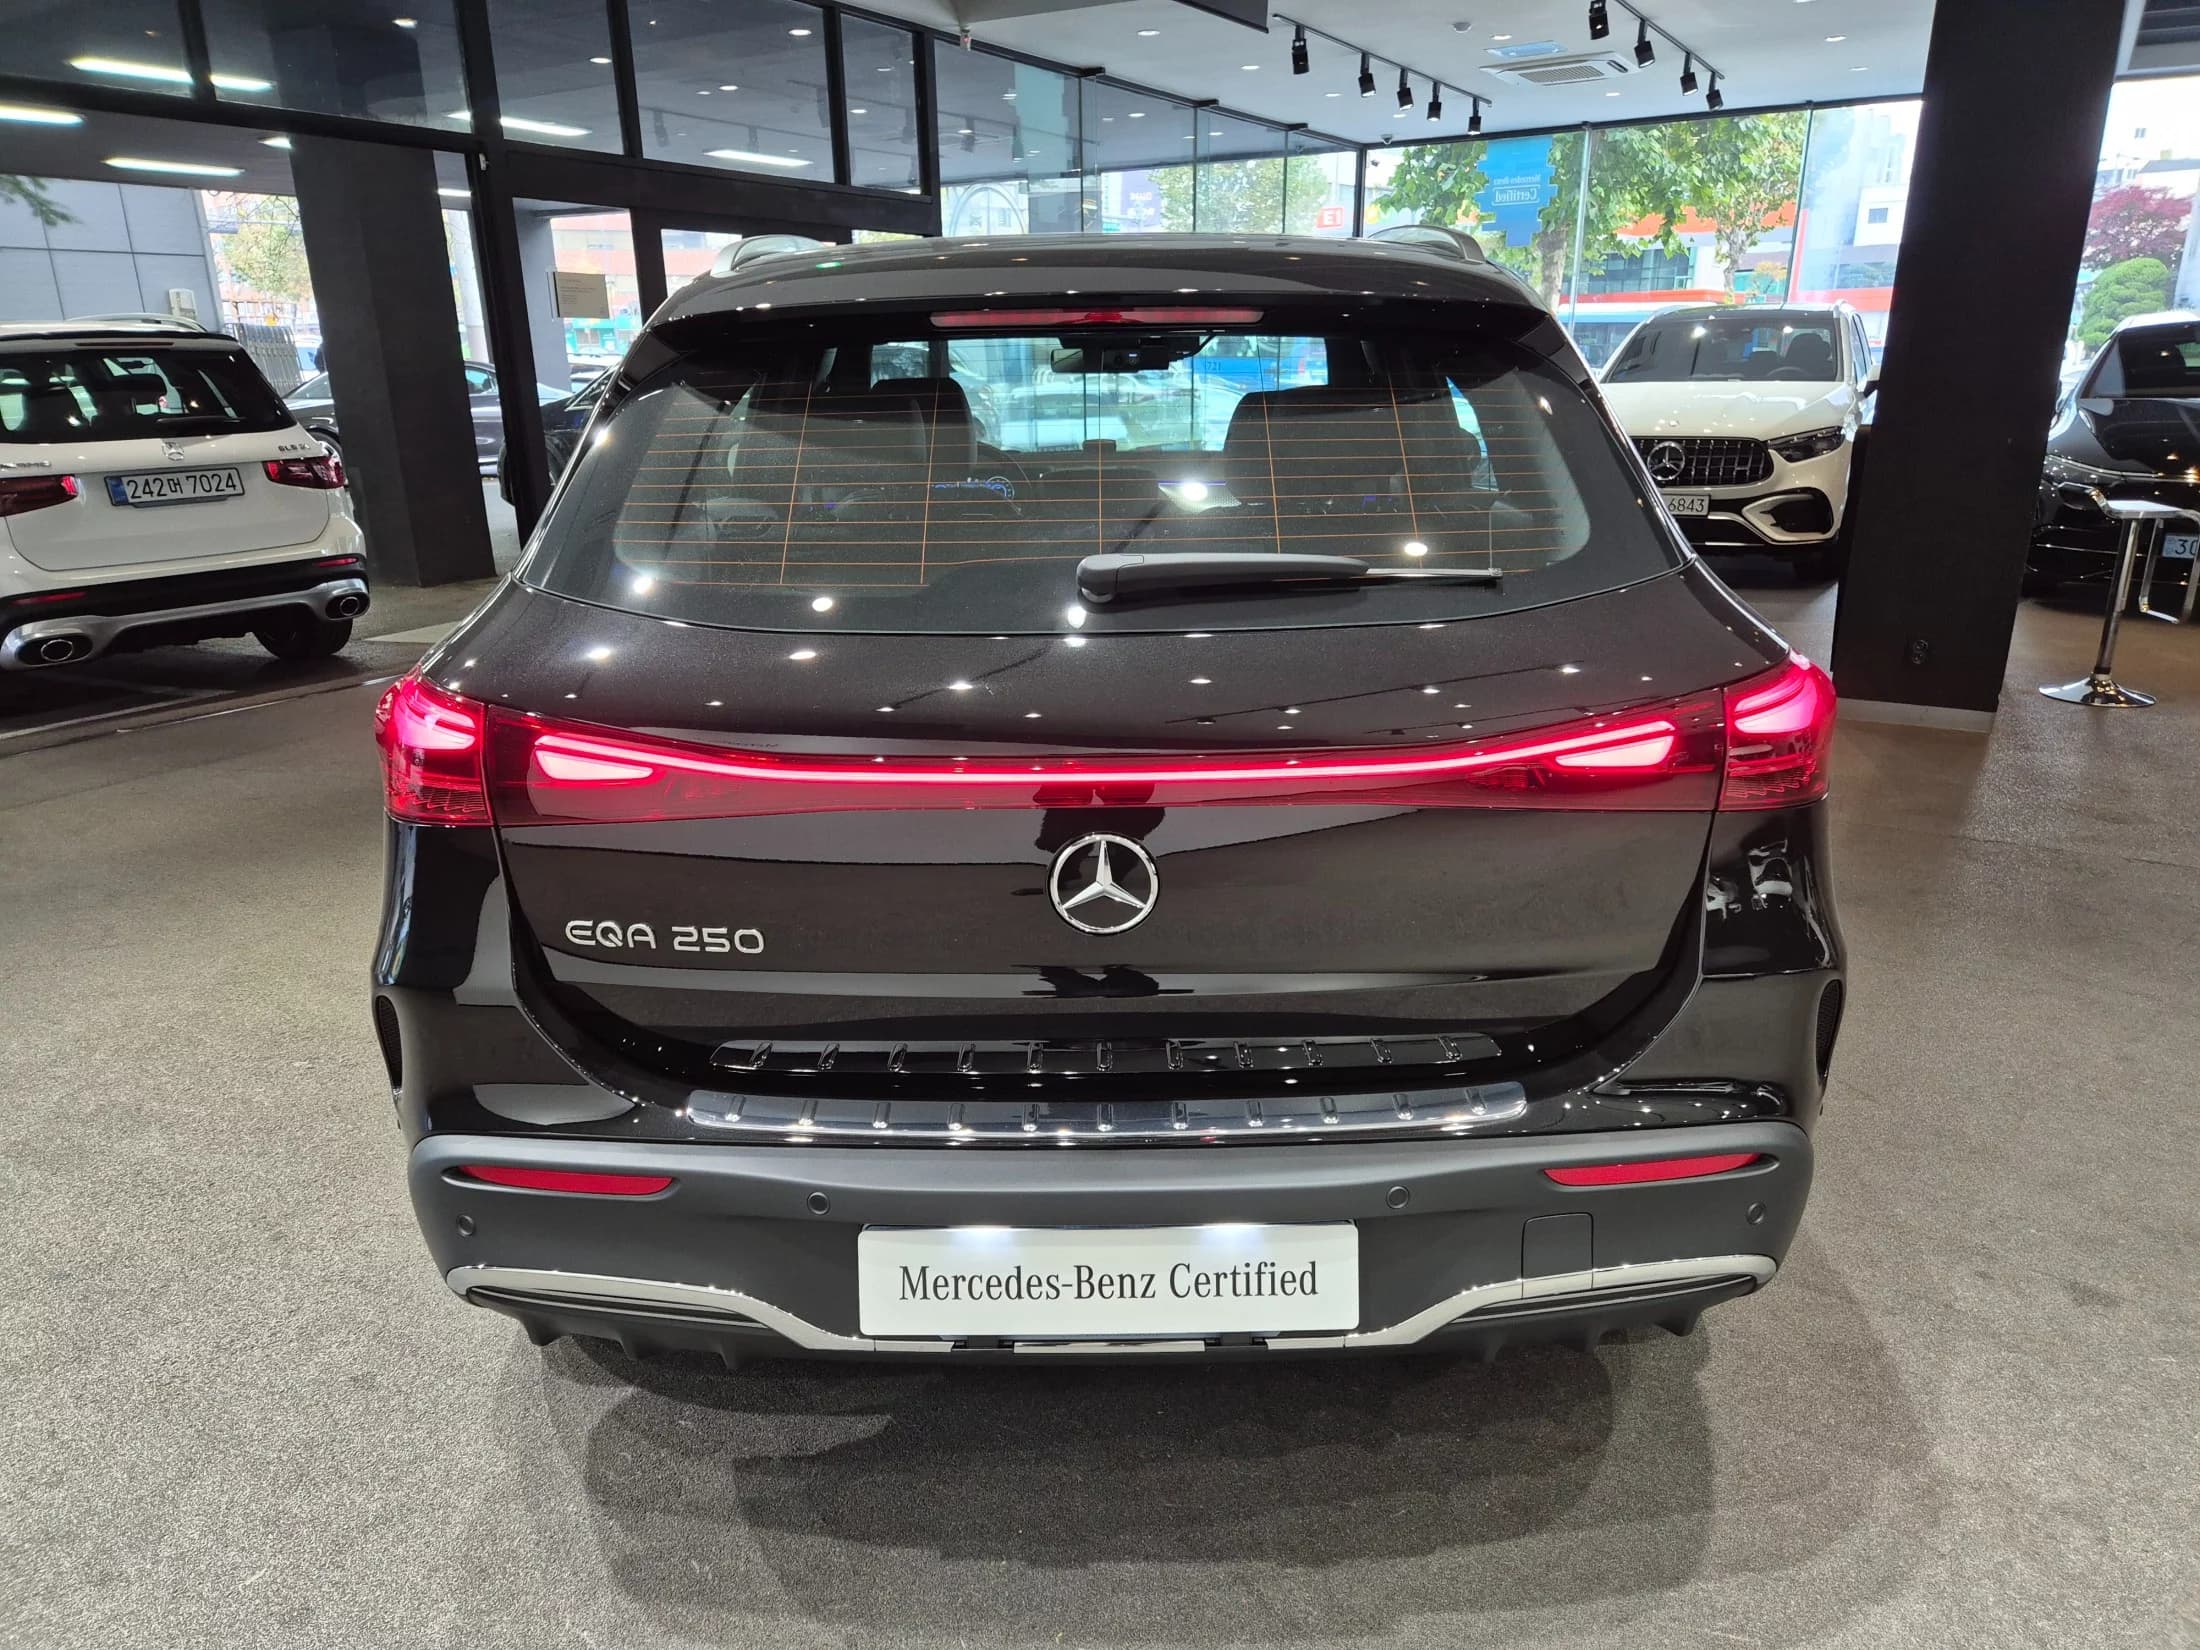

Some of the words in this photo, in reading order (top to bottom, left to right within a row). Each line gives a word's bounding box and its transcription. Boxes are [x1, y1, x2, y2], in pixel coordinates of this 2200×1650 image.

[186, 472, 237, 494] 7024
[1668, 498, 1705, 512] 6843
[565, 919, 657, 951] EQA
[671, 924, 765, 954] 250
[900, 1265, 1156, 1301] Mercedes-Benz
[1169, 1260, 1318, 1297] Certified
